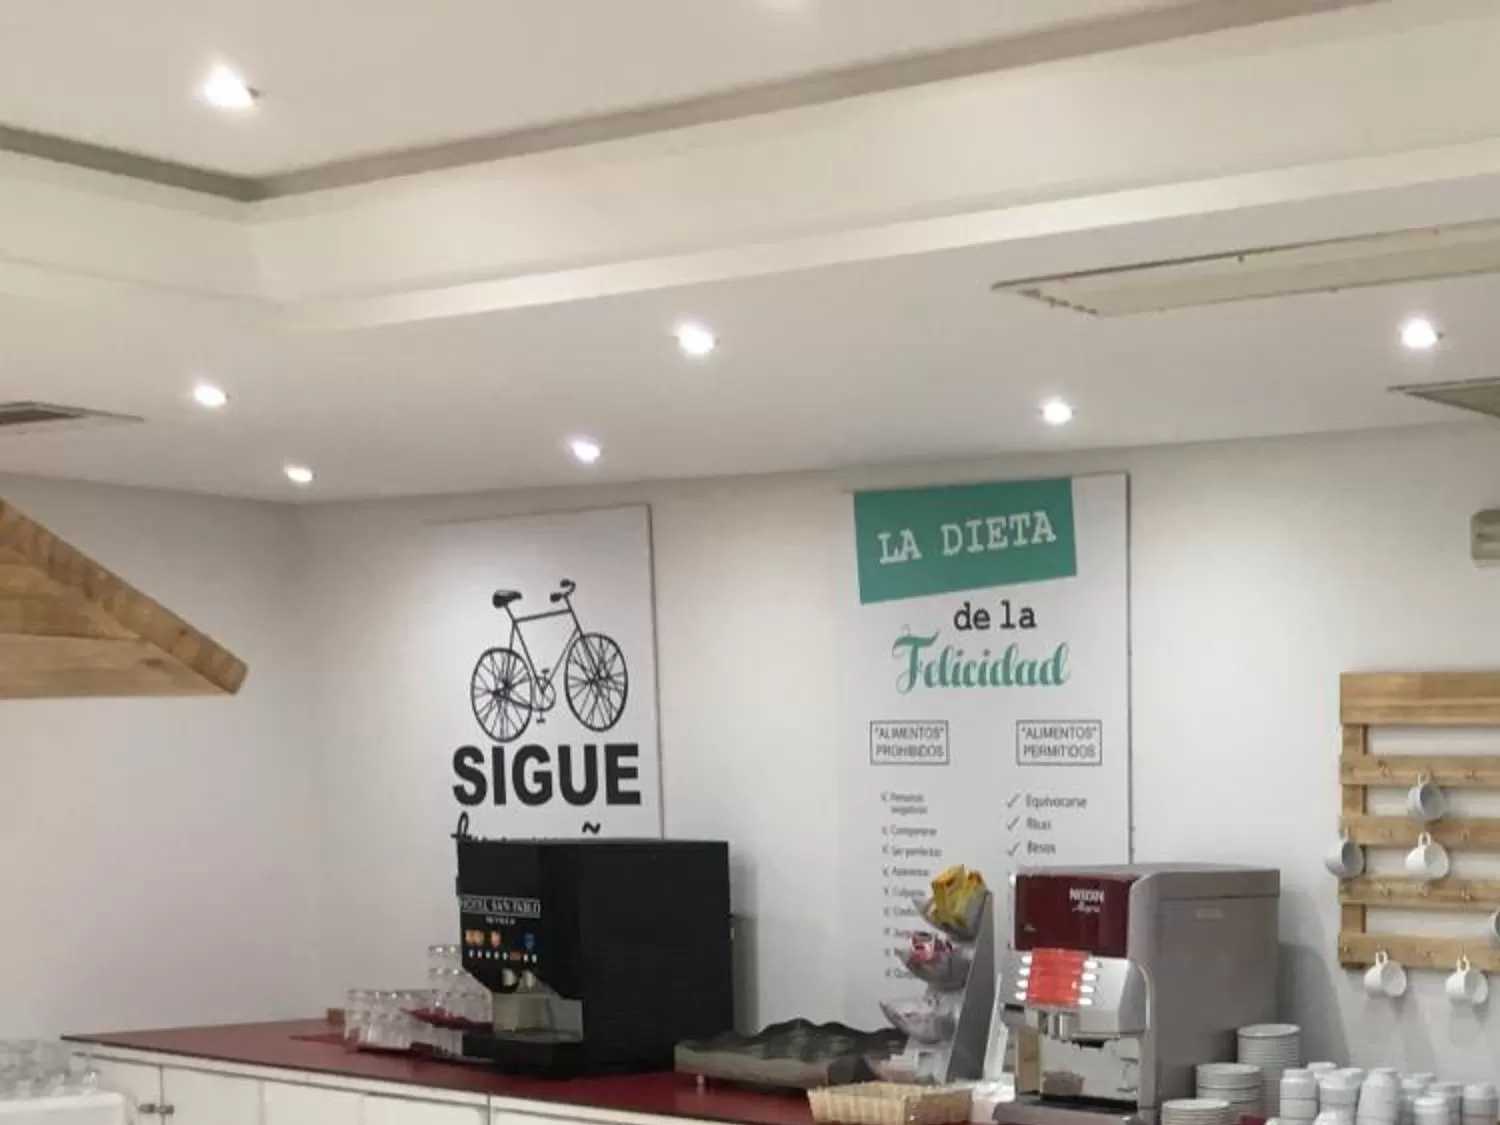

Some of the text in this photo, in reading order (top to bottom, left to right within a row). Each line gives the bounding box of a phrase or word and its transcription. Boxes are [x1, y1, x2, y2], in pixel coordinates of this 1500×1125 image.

[877, 510, 1056, 565] LA DIETA
[953, 600, 1036, 631] de la
[892, 624, 1070, 695] Felicidad
[452, 742, 642, 807] SIGUE
[1023, 743, 1097, 759] PERMITIDOS
